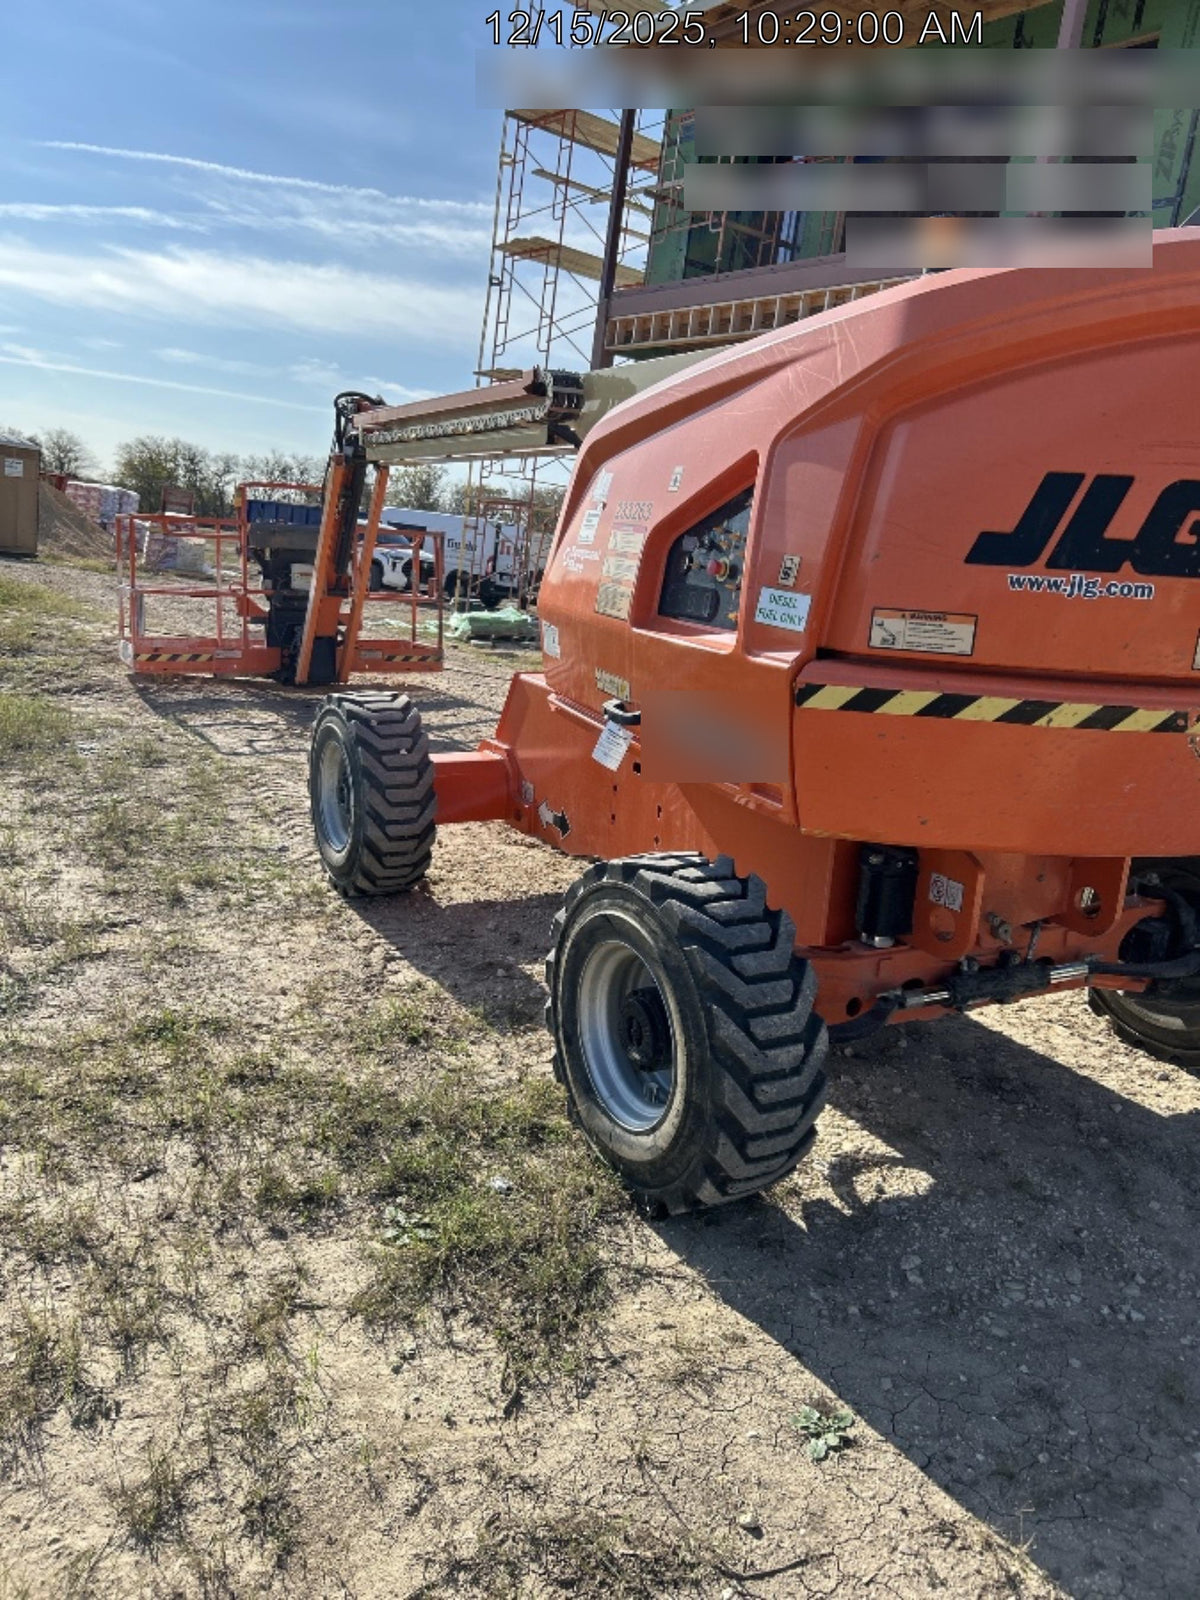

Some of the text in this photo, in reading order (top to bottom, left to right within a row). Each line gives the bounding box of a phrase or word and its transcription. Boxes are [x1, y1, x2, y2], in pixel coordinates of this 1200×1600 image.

[964, 472, 1200, 577] JLG
[1008, 573, 1154, 600] www.jlg.com
[769, 593, 798, 609] DIESEL
